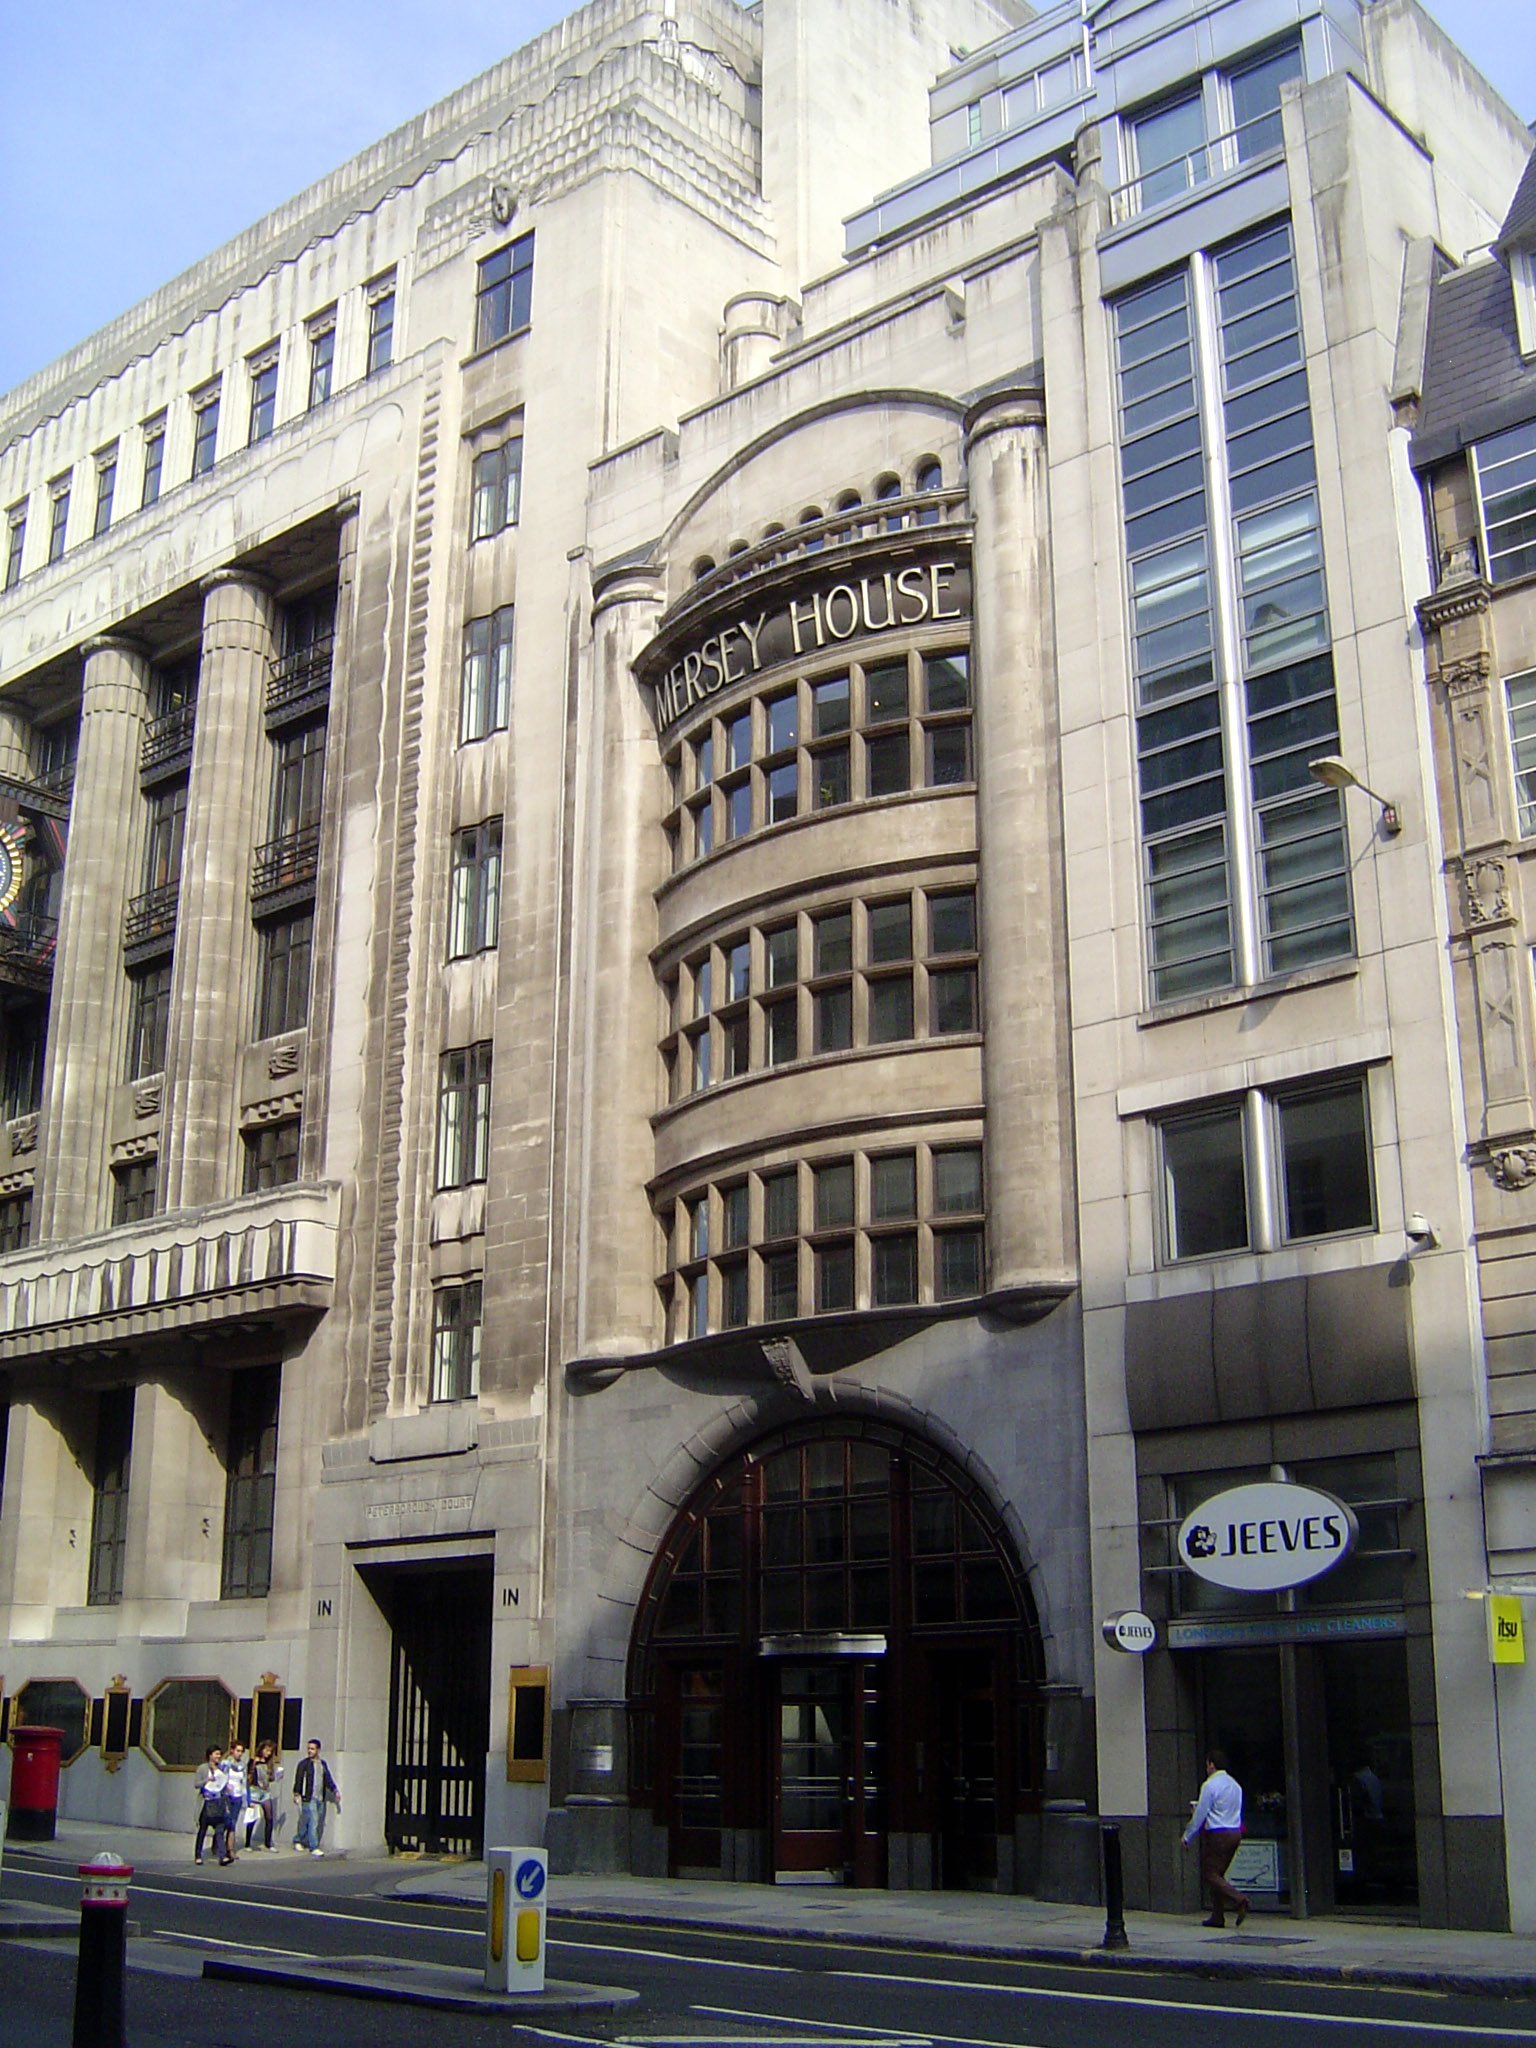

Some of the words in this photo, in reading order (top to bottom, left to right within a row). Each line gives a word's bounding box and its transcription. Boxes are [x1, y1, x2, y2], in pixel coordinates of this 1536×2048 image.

[654, 612, 766, 732] MERSEY
[789, 563, 961, 653] HOUSE
[441, 1497, 472, 1511] COURT
[1221, 1515, 1341, 1557] JEEVES
[502, 1588, 519, 1606] IN
[317, 1600, 332, 1616] IN
[1127, 1625, 1152, 1639] JEEVES
[1297, 1621, 1321, 1633] DRY
[1327, 1616, 1397, 1632] CLEANERS
[1498, 1616, 1518, 1637] itsu
